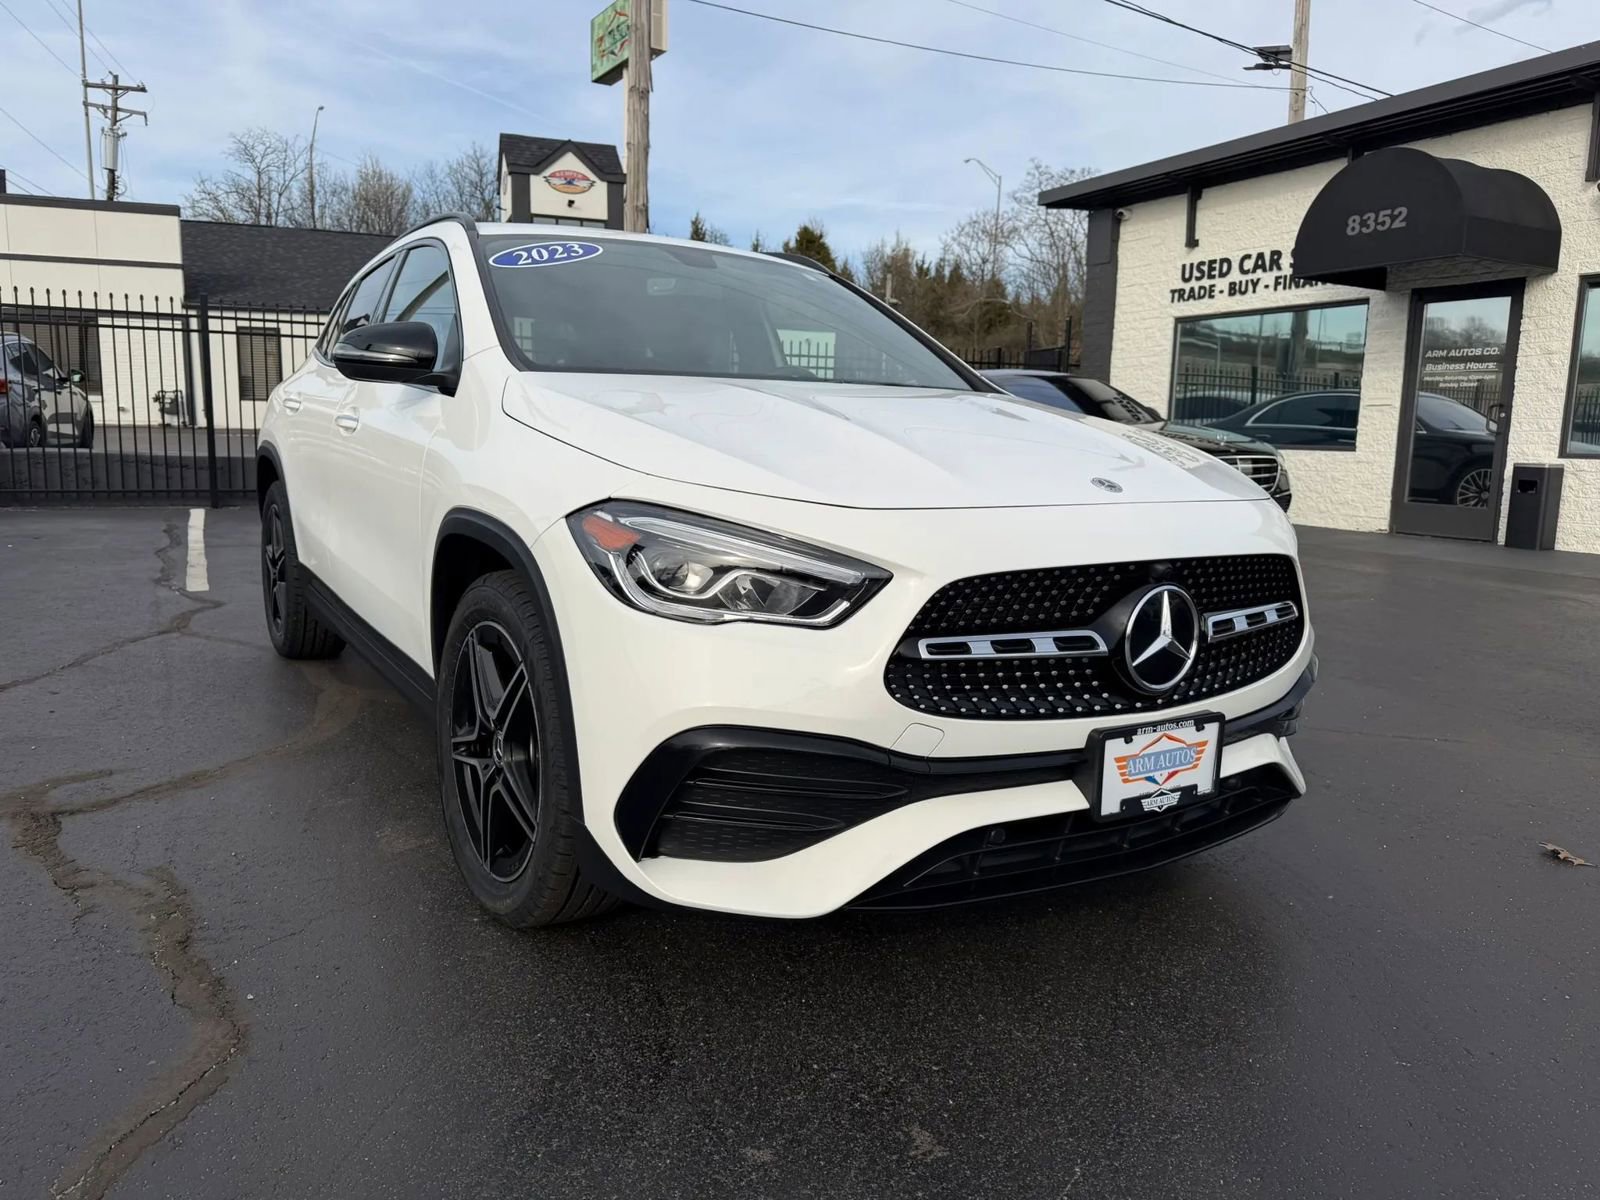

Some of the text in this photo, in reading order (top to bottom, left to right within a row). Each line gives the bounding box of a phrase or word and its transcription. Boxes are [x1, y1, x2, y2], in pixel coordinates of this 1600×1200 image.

[1346, 206, 1408, 236] 8352
[512, 243, 584, 265] 2023
[1181, 257, 1232, 283] USED
[1238, 250, 1283, 275] CAR
[1170, 284, 1216, 303] TRADE
[1228, 278, 1261, 296] BUY
[1273, 273, 1328, 291] FINA
[1425, 346, 1500, 358] ARM AUTOS CO.
[1425, 361, 1497, 371] Business Hours:
[1137, 720, 1195, 735] arm-autos.com
[1128, 748, 1197, 774] ARM AUTOS
